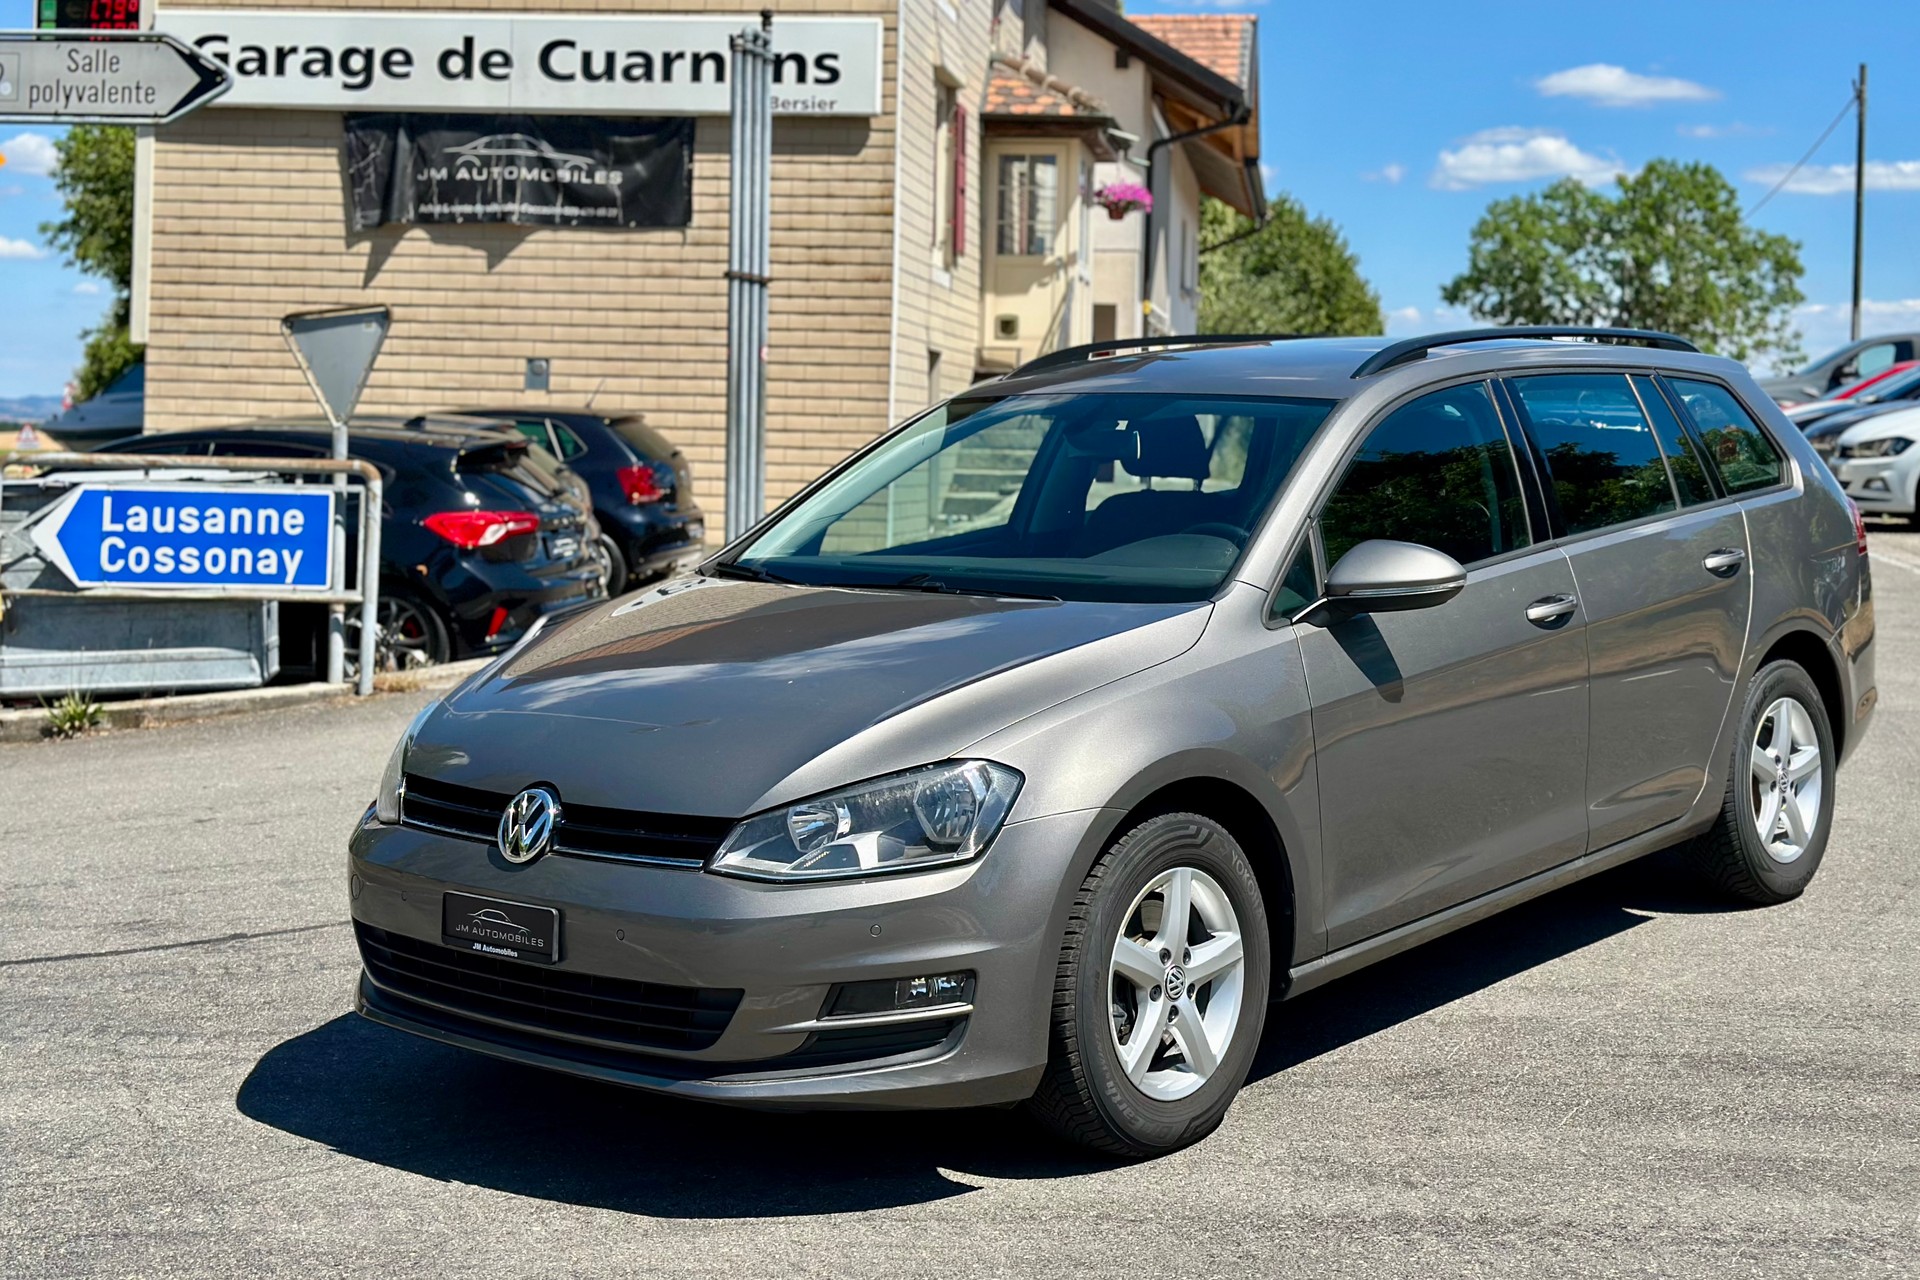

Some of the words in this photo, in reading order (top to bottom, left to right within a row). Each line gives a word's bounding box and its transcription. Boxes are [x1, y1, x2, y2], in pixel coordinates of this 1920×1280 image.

[66, 48, 120, 73] Salle
[436, 36, 514, 81] de
[538, 39, 841, 85] Cuarnns
[29, 78, 156, 109] polyvalente
[416, 166, 448, 181] JM
[455, 165, 624, 185] AUTOMOBILES
[101, 495, 305, 536] Lausanne
[100, 536, 304, 584] Cossonay
[455, 924, 469, 933] JM
[472, 926, 545, 947] AUTOMOBILES
[472, 942, 482, 951] JM
[482, 944, 518, 958] Automobiles
